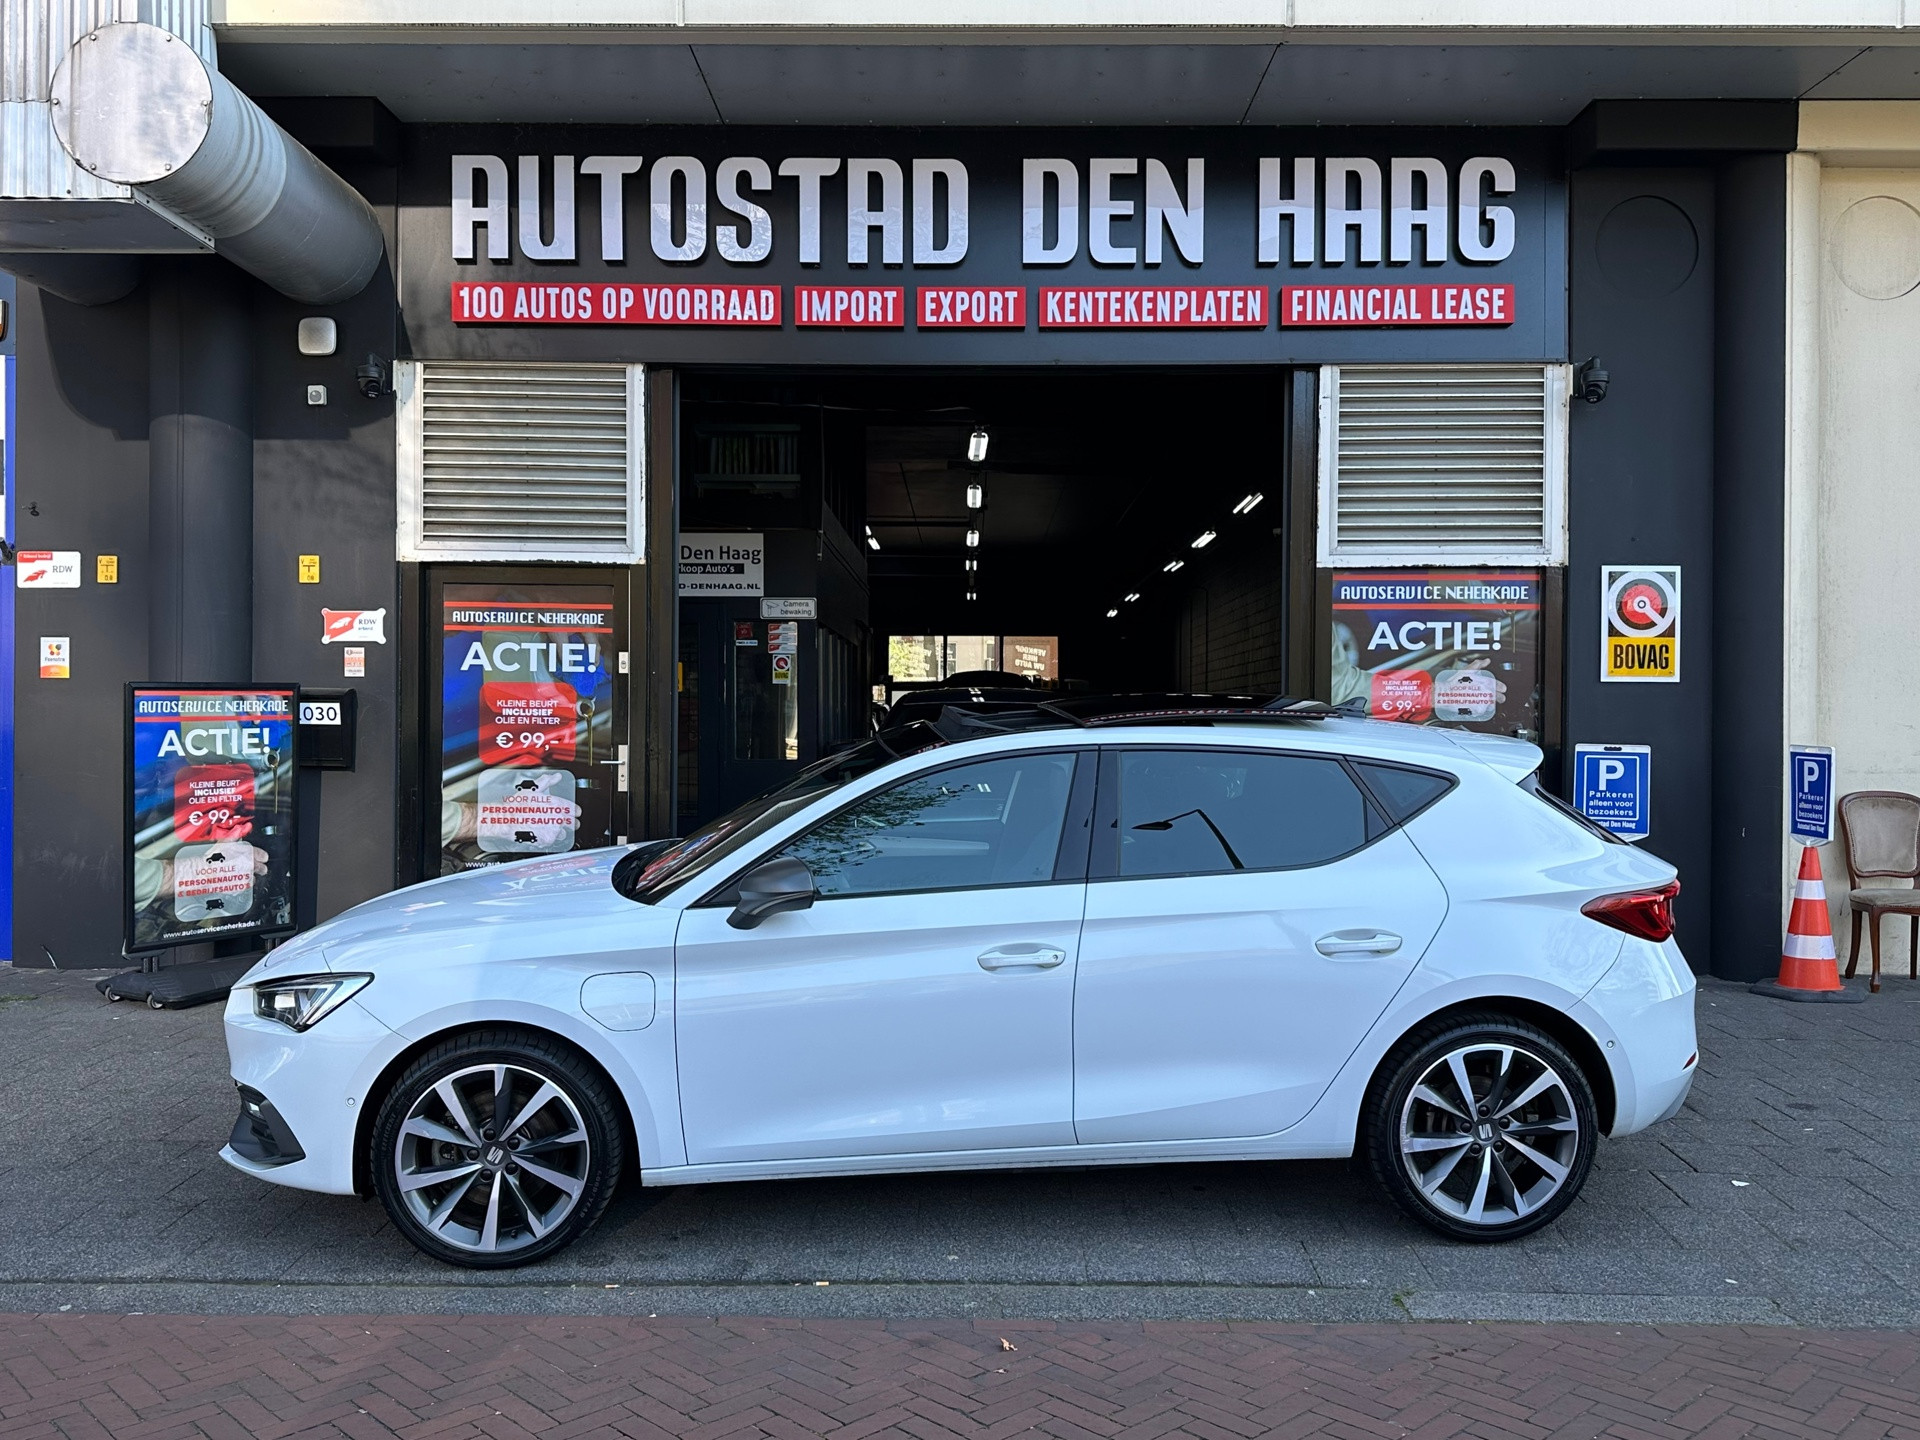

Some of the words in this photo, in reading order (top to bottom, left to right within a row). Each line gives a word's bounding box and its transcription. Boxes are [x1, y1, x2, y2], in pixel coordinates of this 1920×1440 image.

[451, 155, 969, 264] AUTOSTAD
[1022, 158, 1204, 265] DEN
[1258, 157, 1516, 263] HAAG
[459, 287, 504, 319] 100
[514, 287, 592, 319] AUTOS
[604, 287, 635, 320] OP
[644, 288, 775, 321] VOORRAAD
[802, 290, 897, 323] IMPORT
[925, 290, 1017, 323] EXPORT
[1047, 290, 1261, 323] KENTEKENPLATEN
[1292, 288, 1421, 320] FINANCIAL
[1432, 288, 1506, 320] LEASE
[681, 546, 714, 559] Den
[720, 546, 761, 564] Haag
[706, 565, 734, 573] Auto's
[1341, 586, 1441, 599] AUTOSERVICE
[1445, 586, 1528, 599] NEHERKADE
[453, 611, 534, 624] AUTOSERVICE
[537, 612, 604, 625] NEHERKADE
[1367, 622, 1501, 651] ACTIE!
[460, 642, 597, 673] ACTIE!
[1614, 644, 1669, 669] BOVAG
[139, 700, 221, 713] AUTOSERVICE
[225, 700, 288, 712] NEHERKADE
[497, 700, 527, 708] KLEINE
[529, 700, 558, 708] BEURT
[300, 706, 337, 721] 030
[502, 708, 553, 716] INCLUSIEF
[495, 716, 515, 724] OLIE
[532, 717, 560, 725] FILTER
[158, 728, 270, 757] ACTIE!
[520, 732, 559, 751] 99,-
[1599, 760, 1624, 790] P
[1803, 761, 1819, 792] P
[189, 781, 215, 789] KLEINE
[217, 779, 240, 787] BEURT
[195, 788, 236, 796] INCLUSIEF
[503, 795, 528, 803] VOOR
[531, 795, 551, 803] ALLE
[1799, 793, 1823, 801] Parkeren
[189, 796, 205, 804] OLIE
[219, 795, 242, 803] FILTER
[482, 806, 570, 814] PERSONENAUTO'S
[1589, 808, 1633, 816] bezoekers
[1799, 811, 1822, 819] bezoekers
[208, 810, 241, 825] 99,-
[490, 817, 572, 825] BEDRIJFSAUTO'S
[196, 867, 217, 876] VOOR
[219, 865, 236, 873] ALLE
[178, 873, 250, 888] PERSONENAUTO'S
[186, 883, 250, 897] BEDRIJFSAUTO'S
[163, 919, 261, 939] www.autoserviceneherkade.nl
